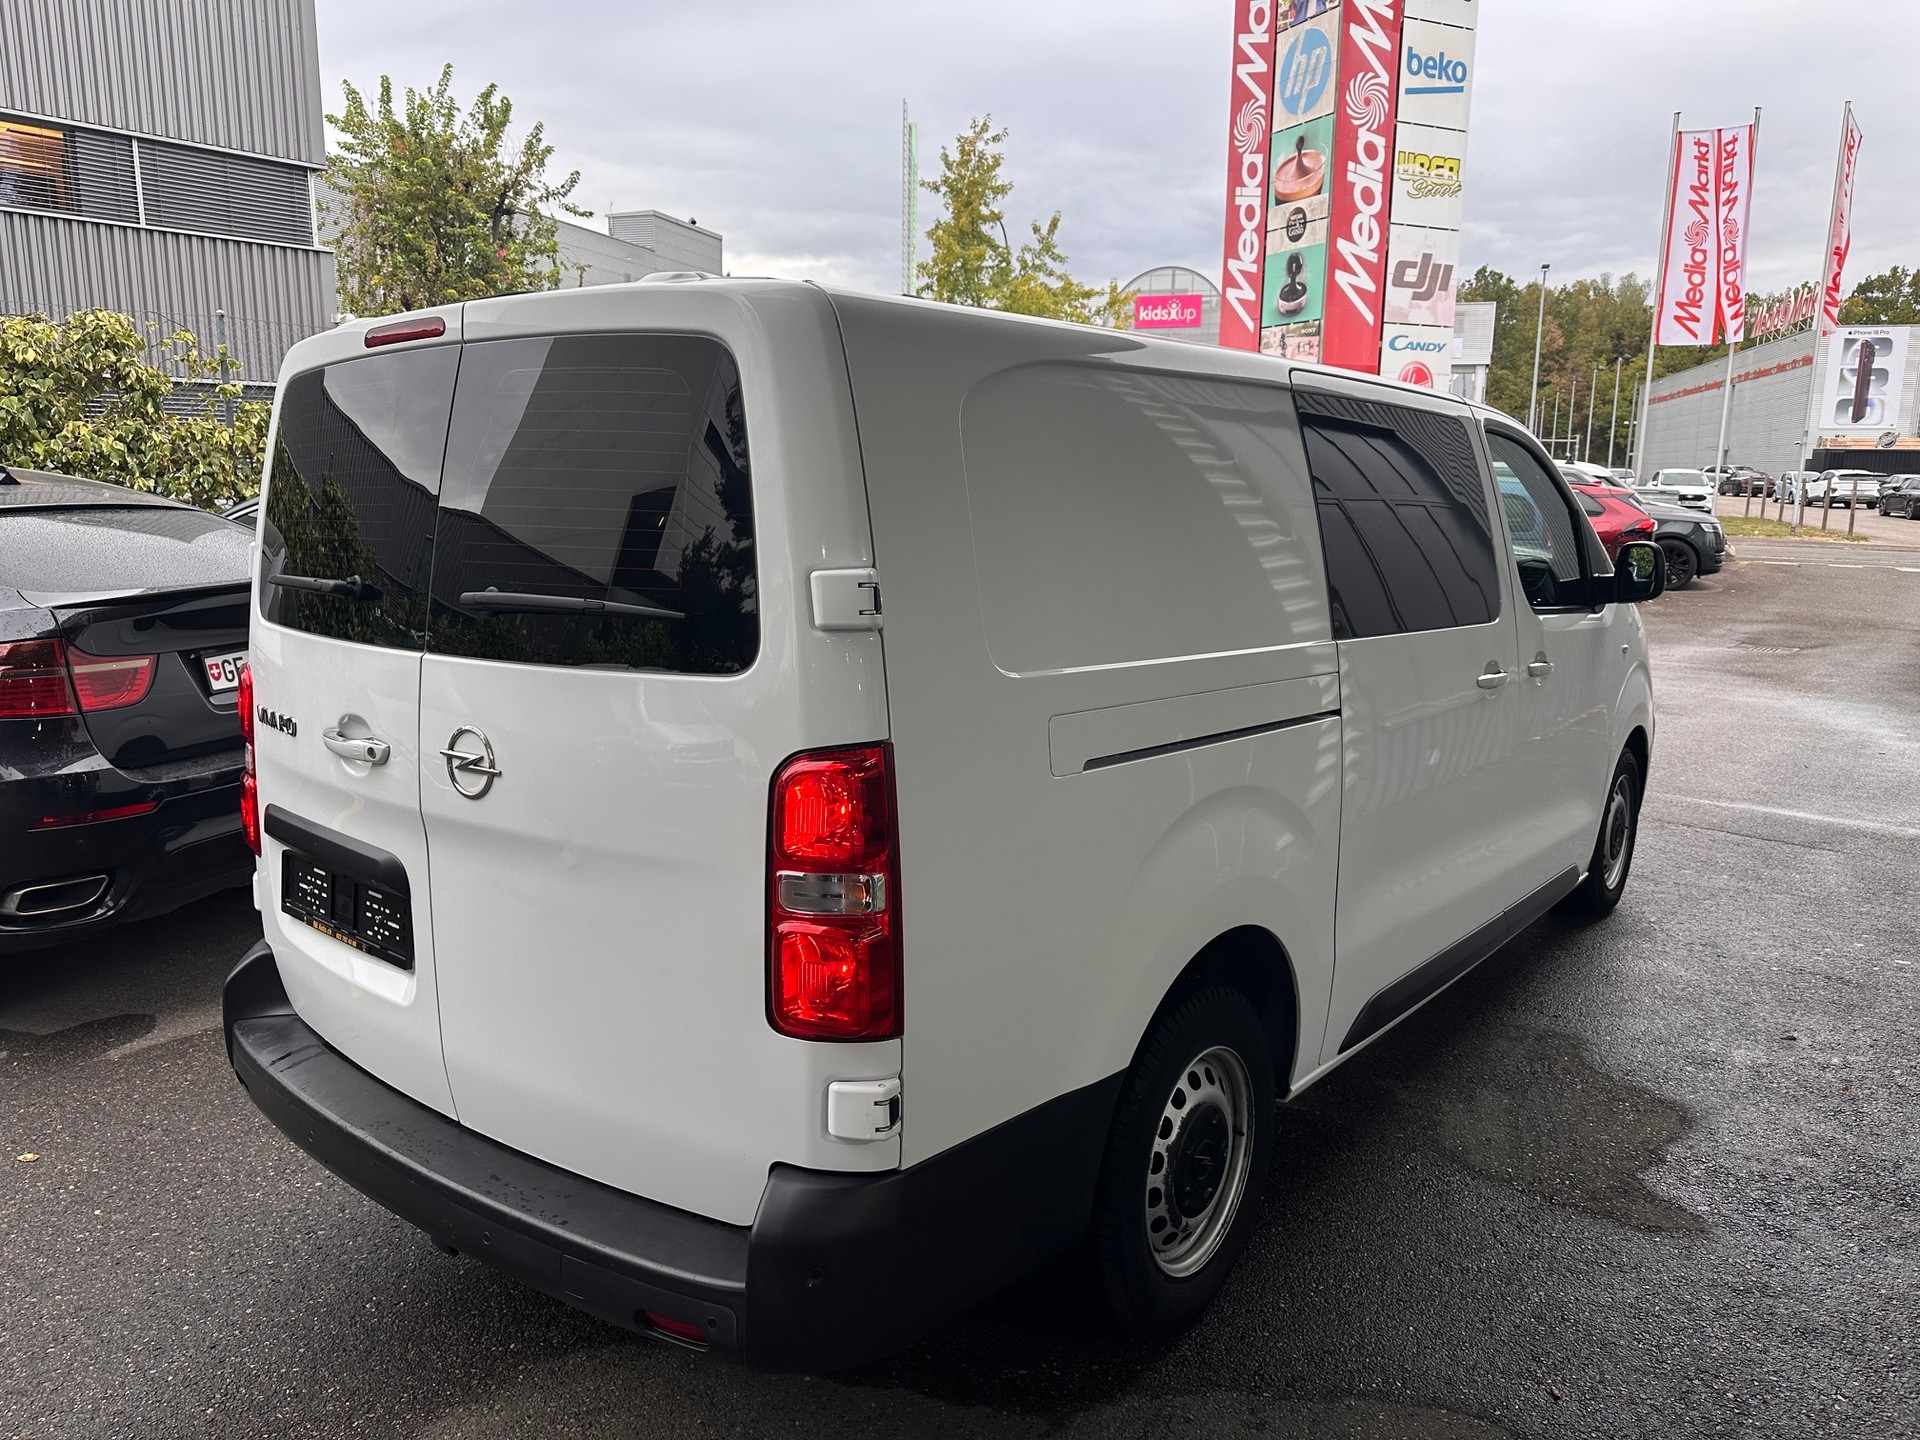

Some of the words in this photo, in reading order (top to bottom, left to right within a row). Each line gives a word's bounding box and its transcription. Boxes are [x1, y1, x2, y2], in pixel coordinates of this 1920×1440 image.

[1283, 34, 1328, 115] hp
[1407, 46, 1467, 83] beko
[1397, 150, 1461, 185] UBER
[1406, 177, 1462, 199] Scoot
[1688, 137, 1710, 225] Markt
[1225, 152, 1264, 333] Media
[1335, 127, 1387, 326] Media
[1139, 305, 1169, 321] kids
[1178, 308, 1197, 324] up
[1673, 246, 1708, 340] Media
